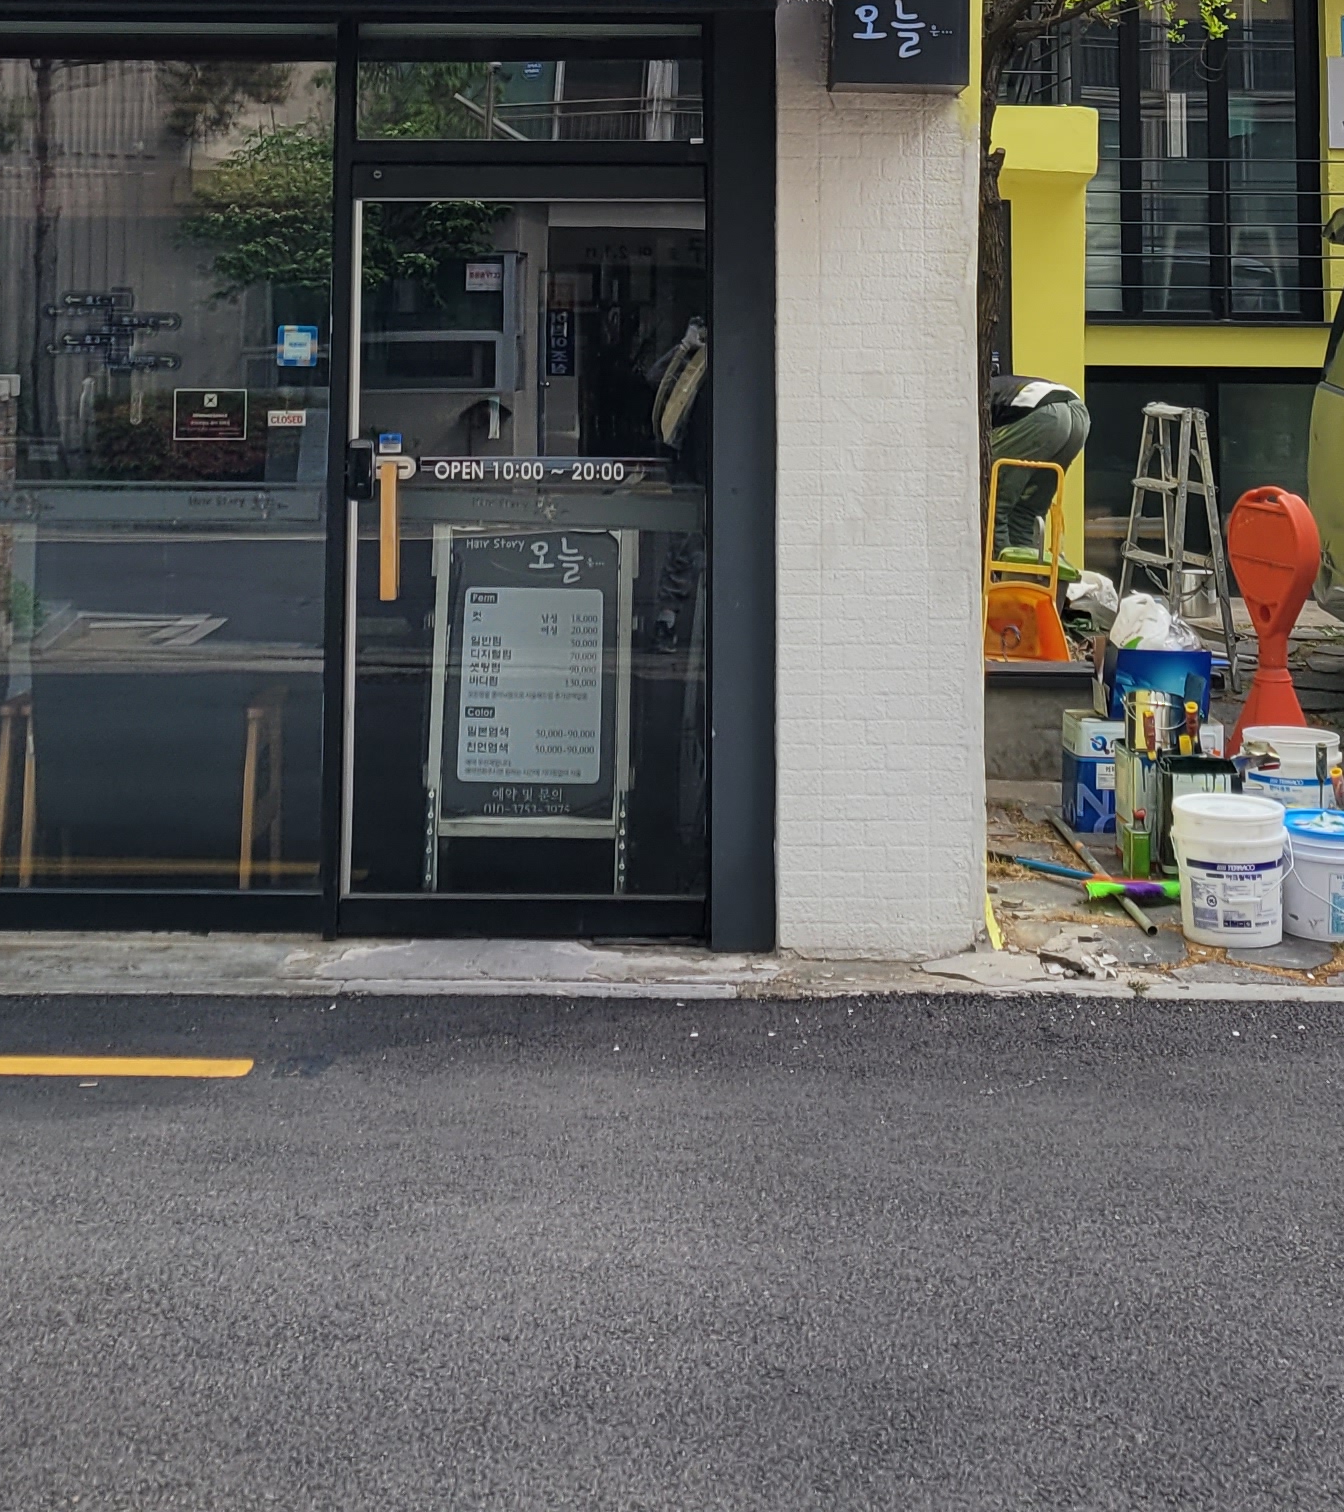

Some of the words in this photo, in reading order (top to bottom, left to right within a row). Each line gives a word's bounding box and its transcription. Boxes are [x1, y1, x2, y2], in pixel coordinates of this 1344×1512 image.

[271, 416, 303, 424] CLOSED
[435, 461, 484, 480] OPEN
[492, 461, 544, 480] 10:00
[572, 462, 624, 481] 20:00
[466, 538, 489, 549] Hair
[493, 538, 525, 552] Story
[472, 594, 495, 603] Perm
[467, 707, 493, 717] Color
